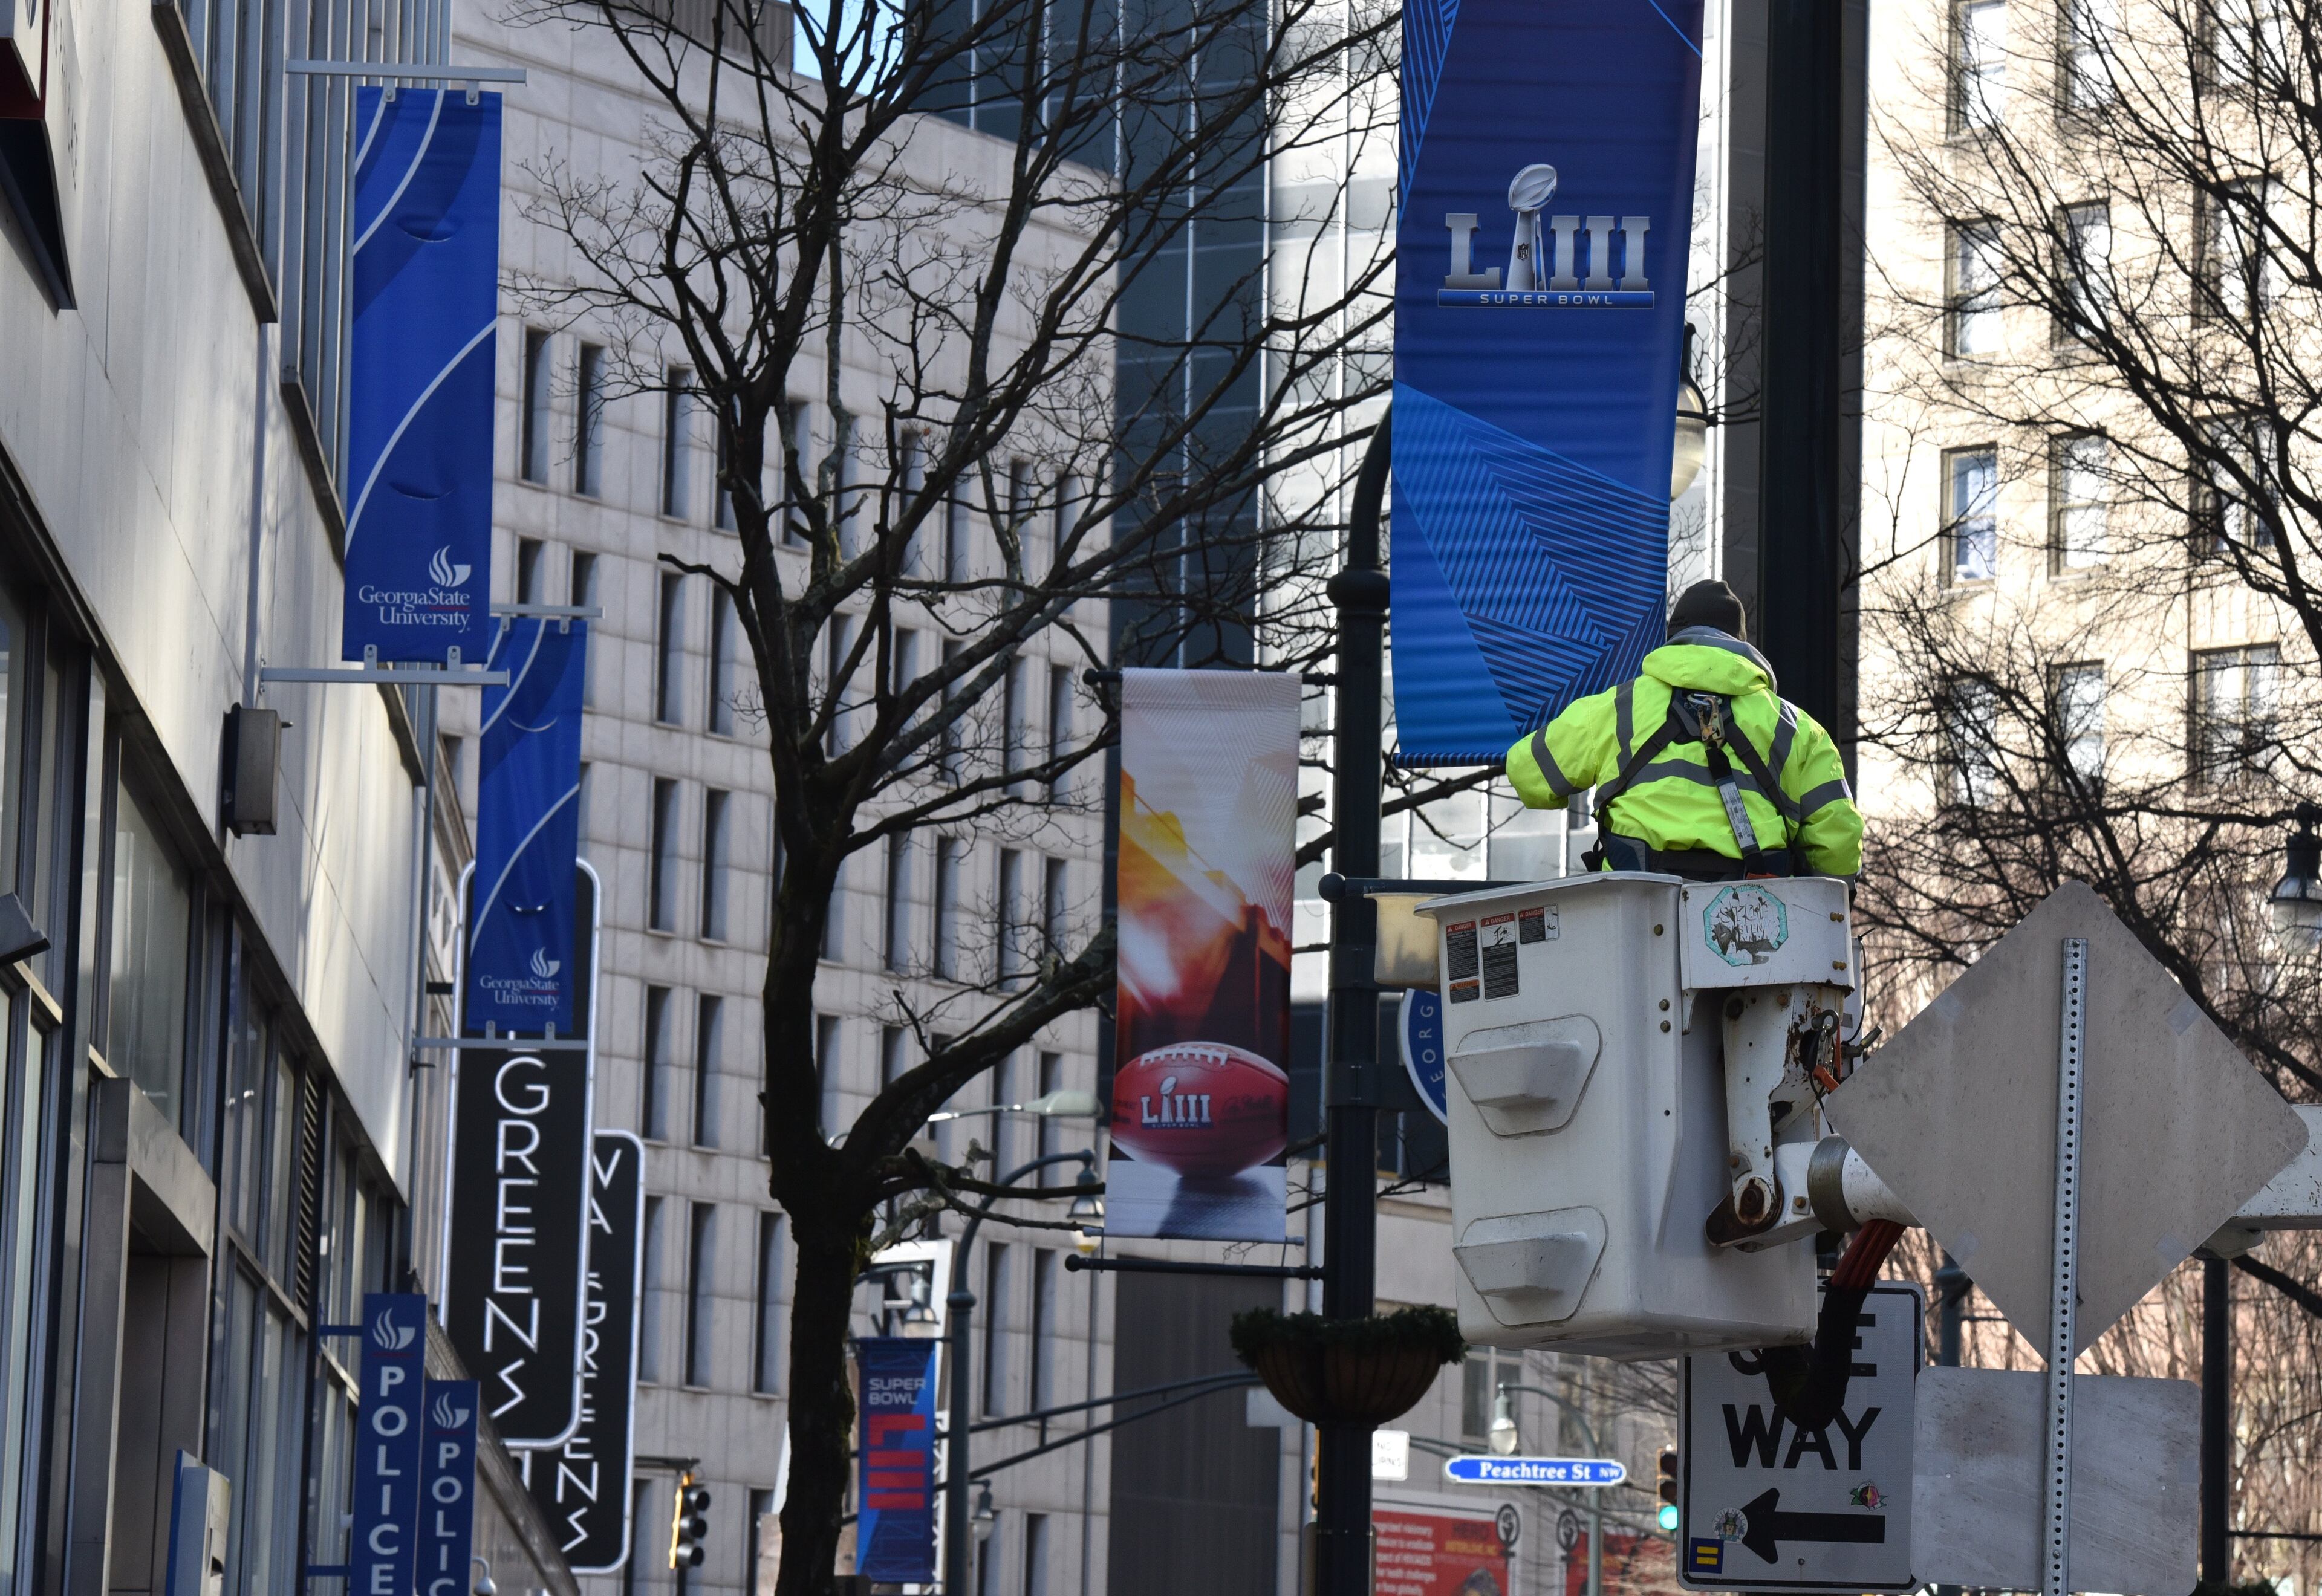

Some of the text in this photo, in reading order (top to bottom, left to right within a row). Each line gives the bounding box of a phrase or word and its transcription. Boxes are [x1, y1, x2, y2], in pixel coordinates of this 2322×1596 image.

[1518, 250, 1529, 259] NFL
[1480, 293, 1613, 305] SUPER BOWL
[379, 606, 471, 634] University
[1490, 915, 1511, 924] DANGER
[1524, 909, 1543, 917] DANGER
[1454, 923, 1472, 931] DANGER
[494, 989, 560, 1011] University
[483, 1030, 551, 1419] GREENS
[868, 1377, 926, 1391] SUPER
[868, 1392, 918, 1406] BOWL
[1722, 1403, 1882, 1471] WAY
[1480, 1461, 1622, 1481] Peachtree St NW
[368, 1365, 408, 1596] POLICE
